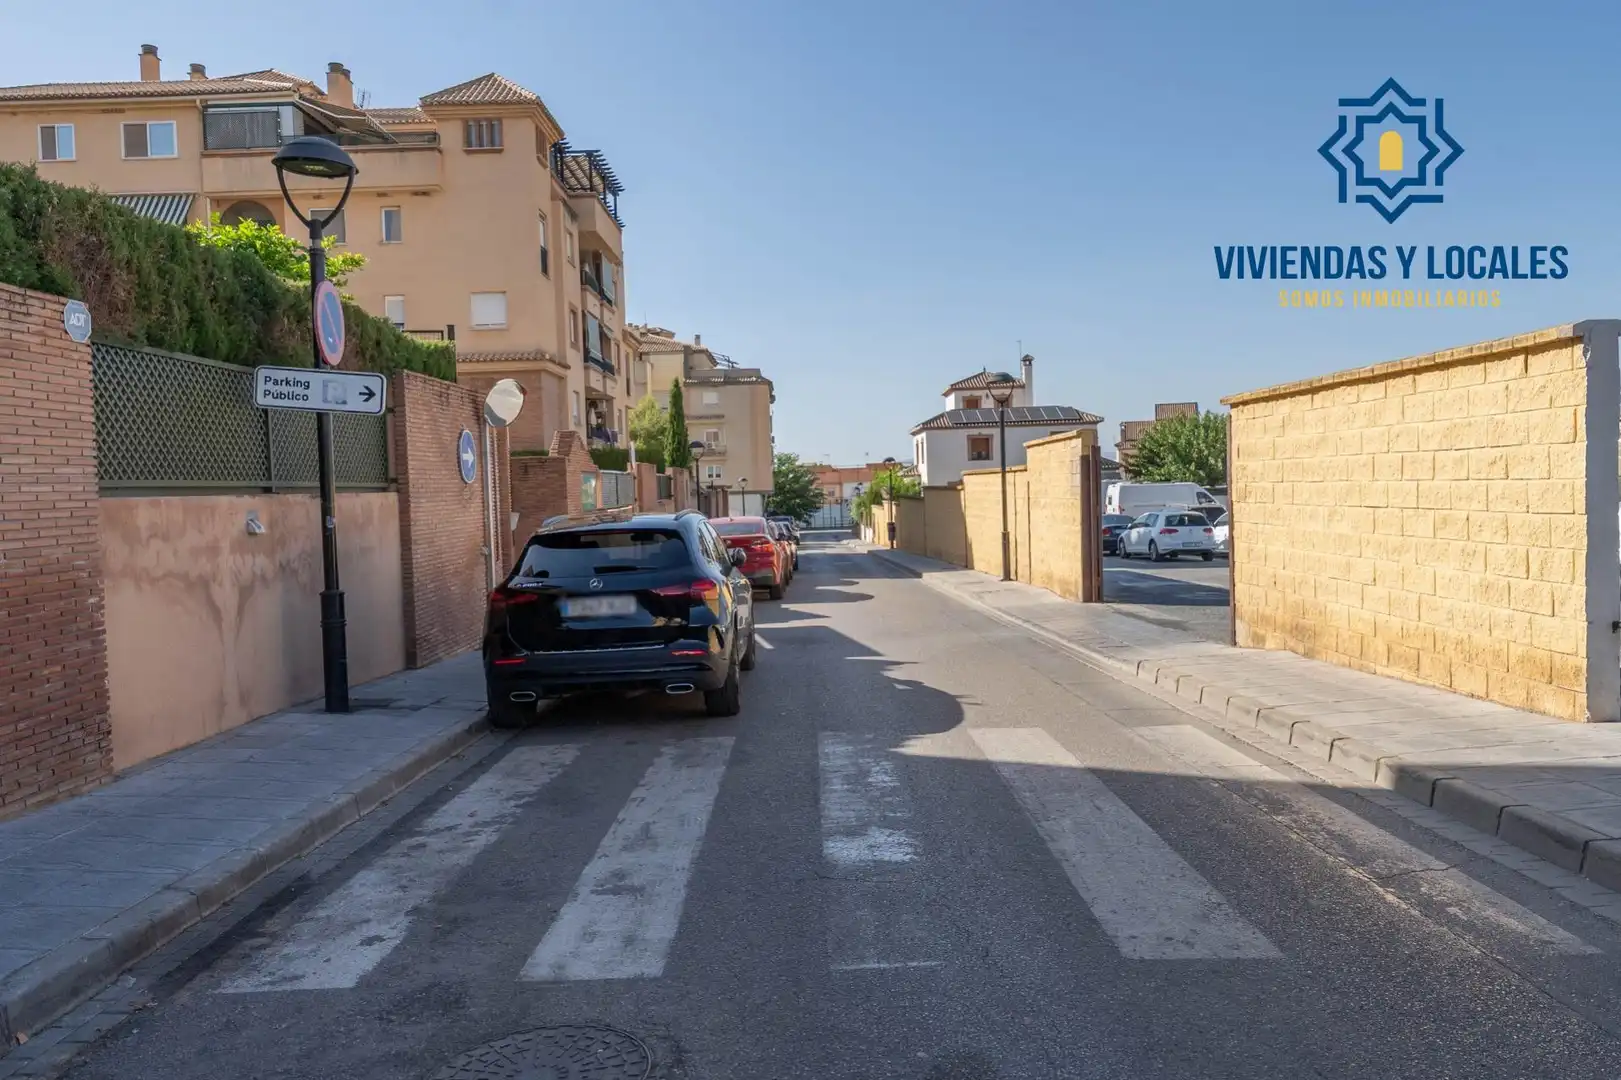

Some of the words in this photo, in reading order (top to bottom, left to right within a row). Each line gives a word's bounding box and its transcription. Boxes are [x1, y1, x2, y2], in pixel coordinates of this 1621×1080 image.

[69, 312, 87, 328] ADT
[263, 375, 311, 390] Parking
[263, 389, 310, 402] Público
